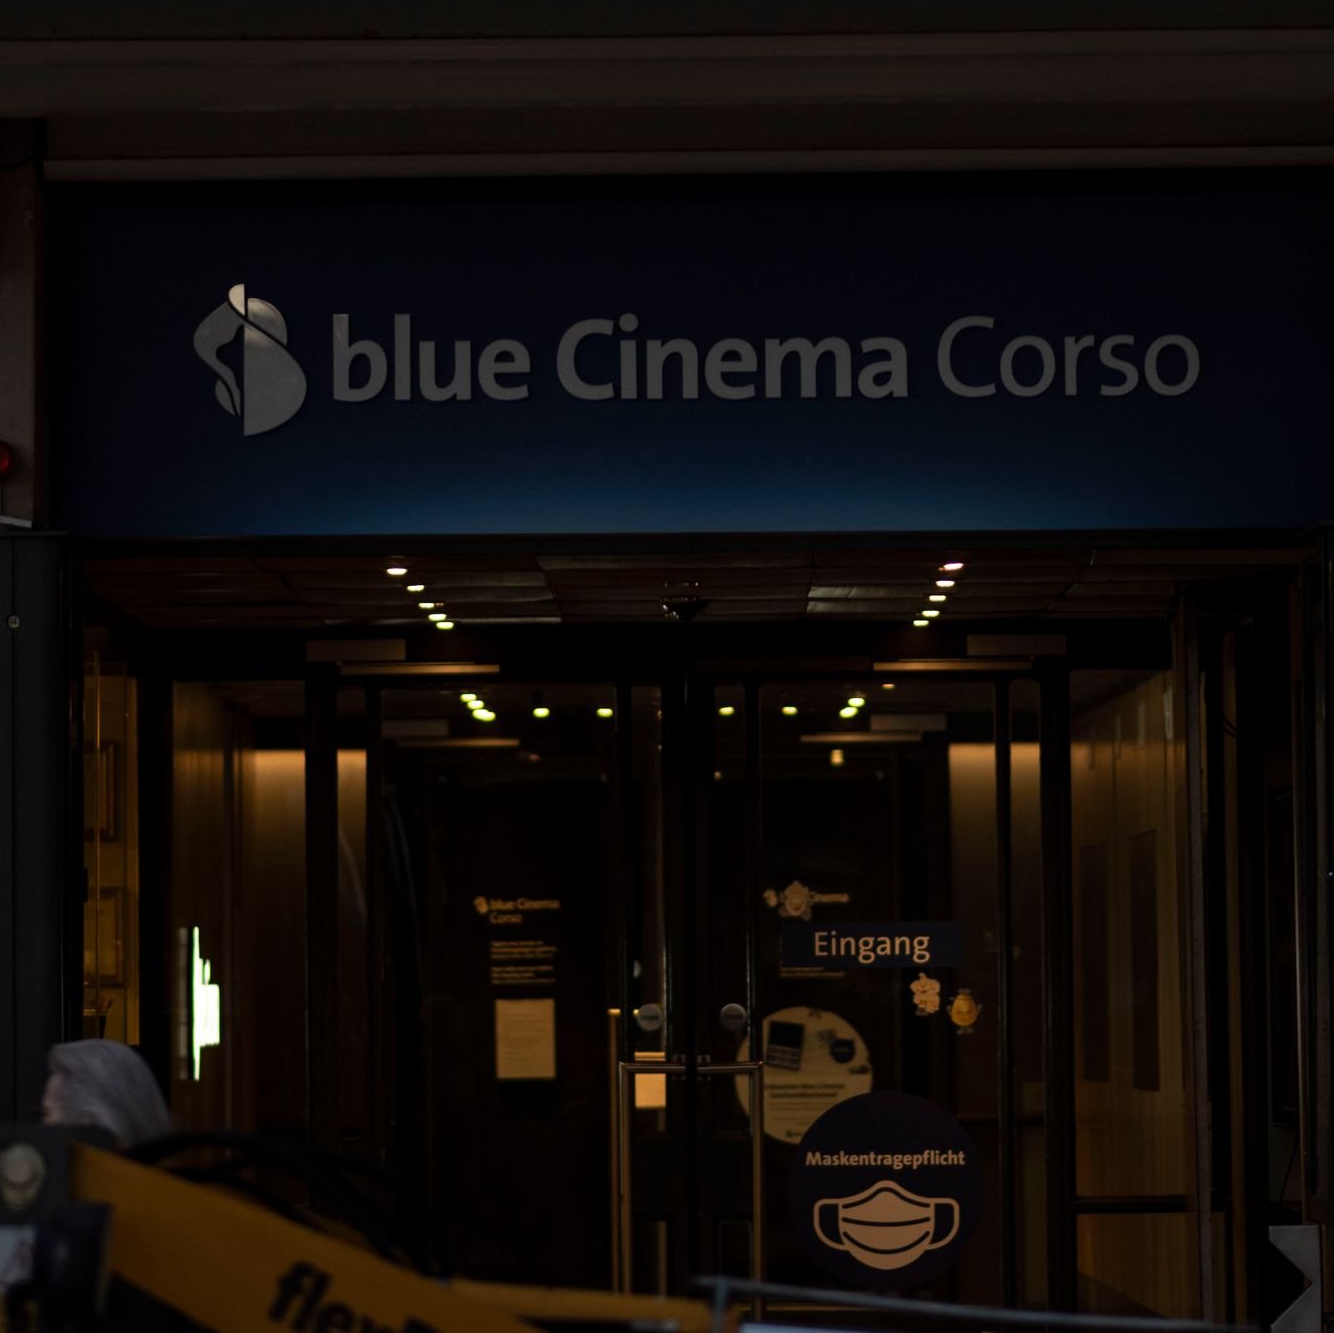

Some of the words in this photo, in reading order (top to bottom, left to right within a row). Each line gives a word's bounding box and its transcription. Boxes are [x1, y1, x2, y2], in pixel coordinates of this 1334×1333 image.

[332, 313, 531, 403] blue
[556, 312, 909, 402] Cinema
[937, 315, 1201, 399] Corso
[813, 930, 931, 964] Eingang
[805, 1149, 966, 1170] Maskentragepflicht
